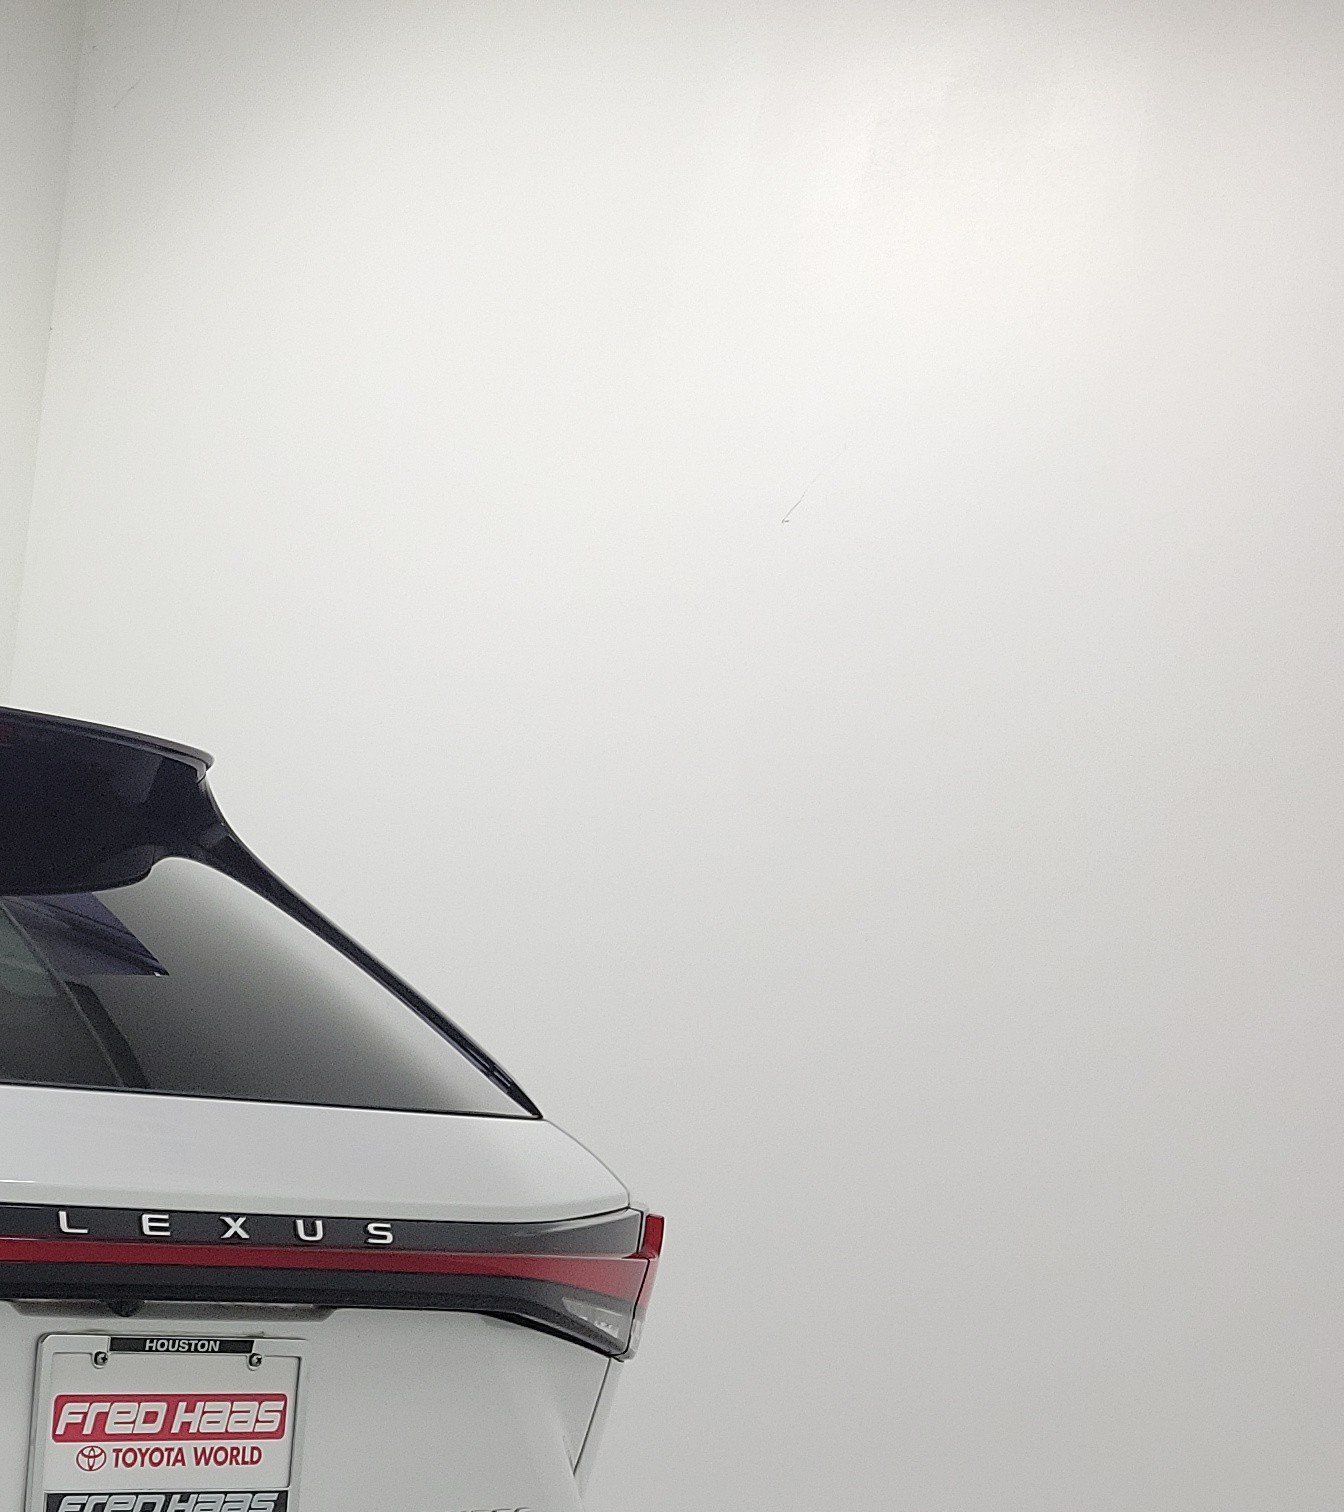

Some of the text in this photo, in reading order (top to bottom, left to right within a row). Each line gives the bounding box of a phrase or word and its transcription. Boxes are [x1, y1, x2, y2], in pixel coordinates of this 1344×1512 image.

[58, 1211, 394, 1245] LEXUS
[145, 1339, 220, 1352] HOUSTON
[112, 1445, 262, 1468] TOYOTA WORLD
